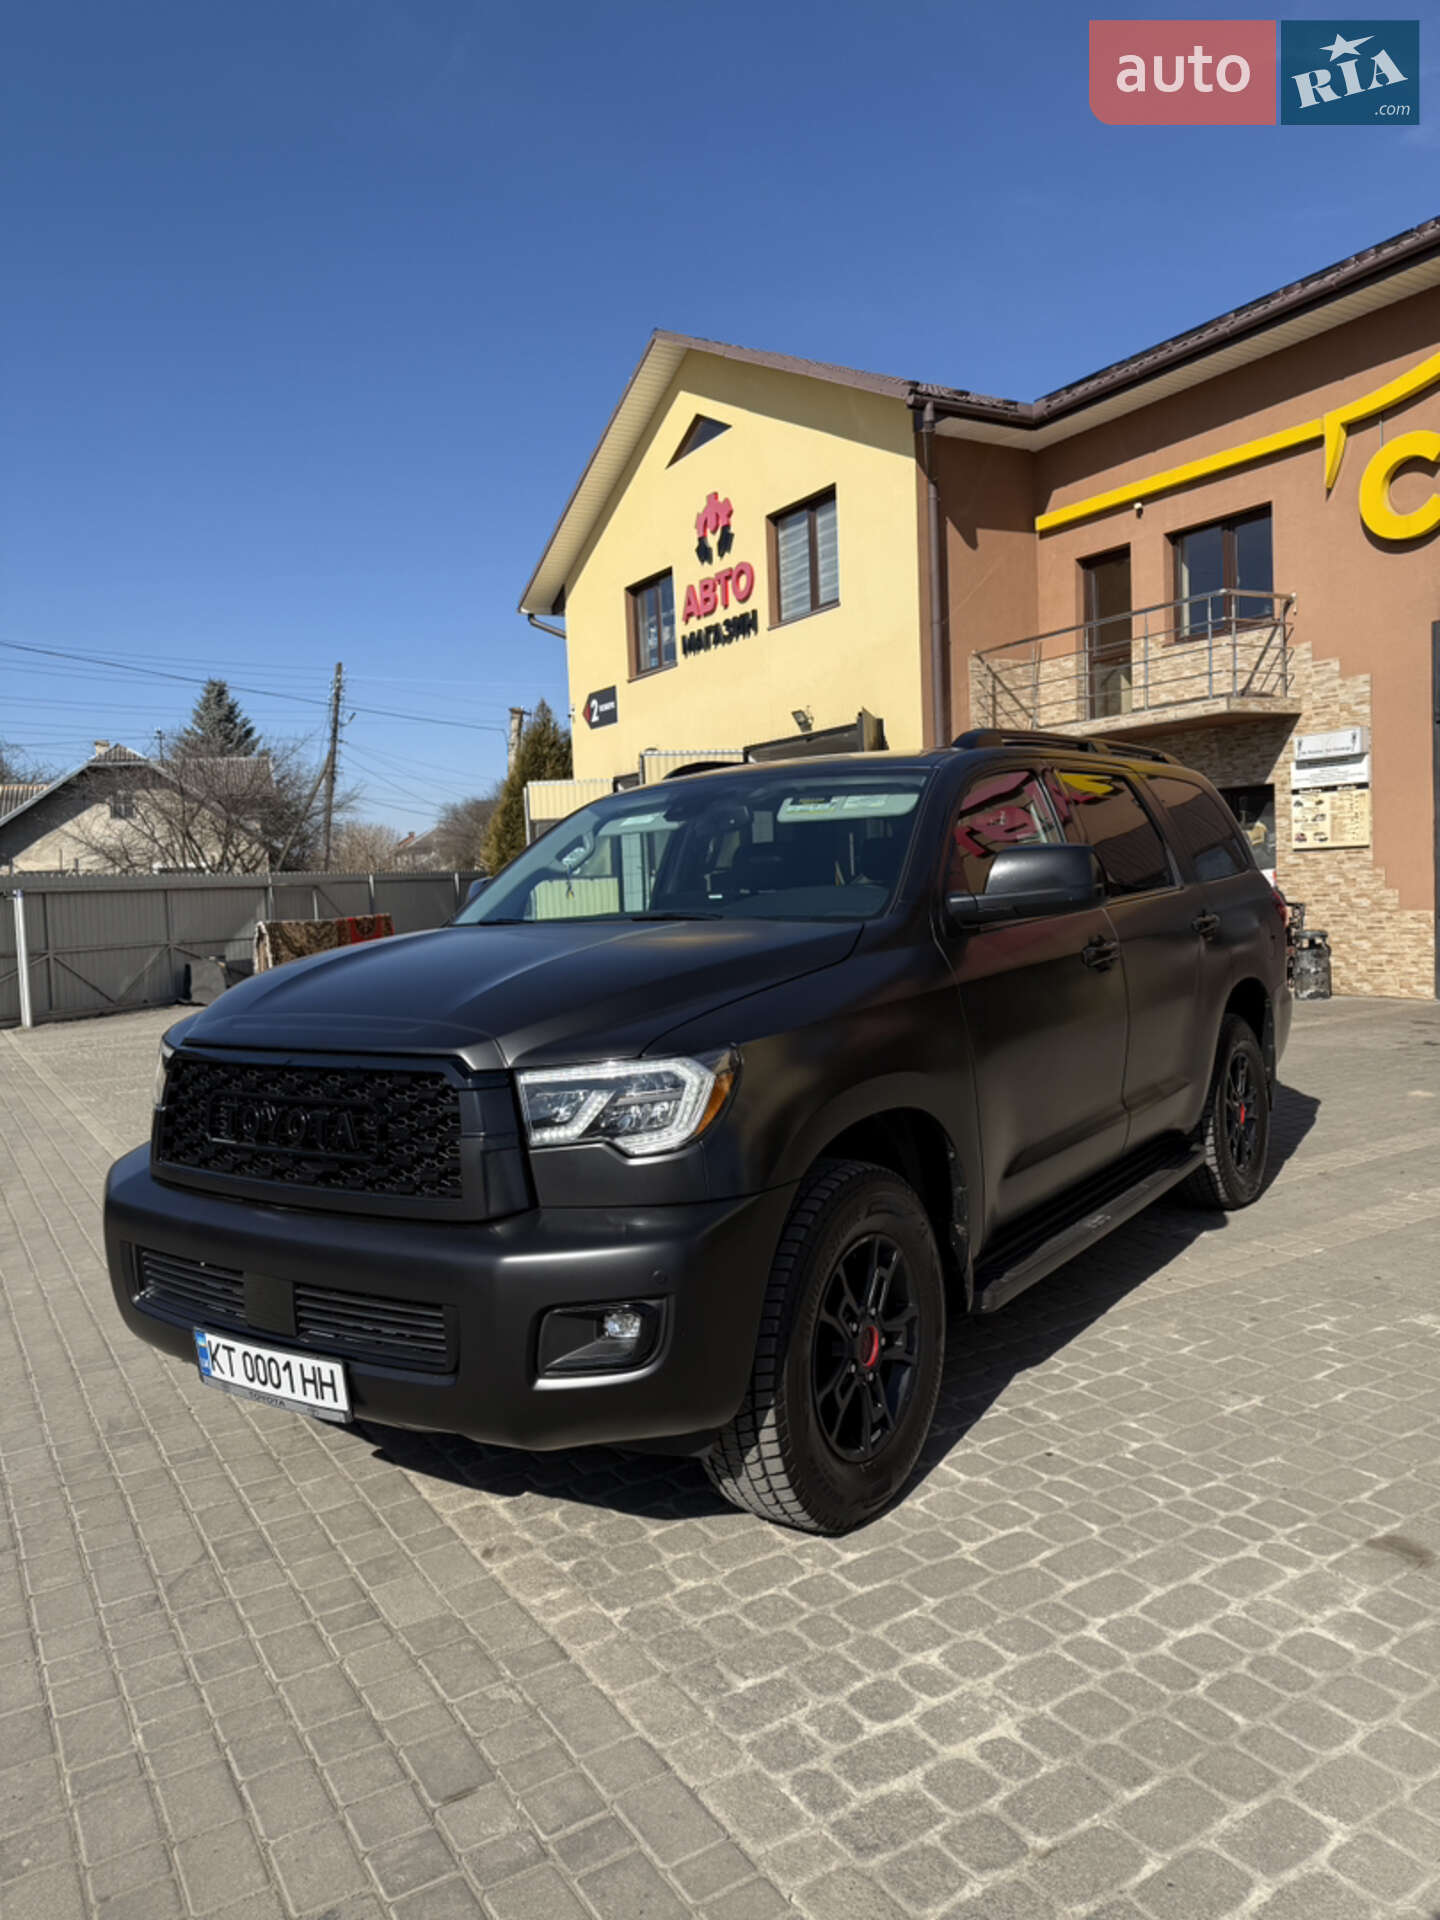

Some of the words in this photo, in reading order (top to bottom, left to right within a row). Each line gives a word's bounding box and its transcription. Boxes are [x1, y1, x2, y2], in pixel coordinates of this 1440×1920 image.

[683, 561, 755, 624] АВТО
[681, 609, 758, 658] МАГАЗИН
[591, 699, 599, 722] 2
[207, 1340, 235, 1377] KT
[242, 1351, 295, 1394] 0001
[299, 1363, 338, 1403] HH
